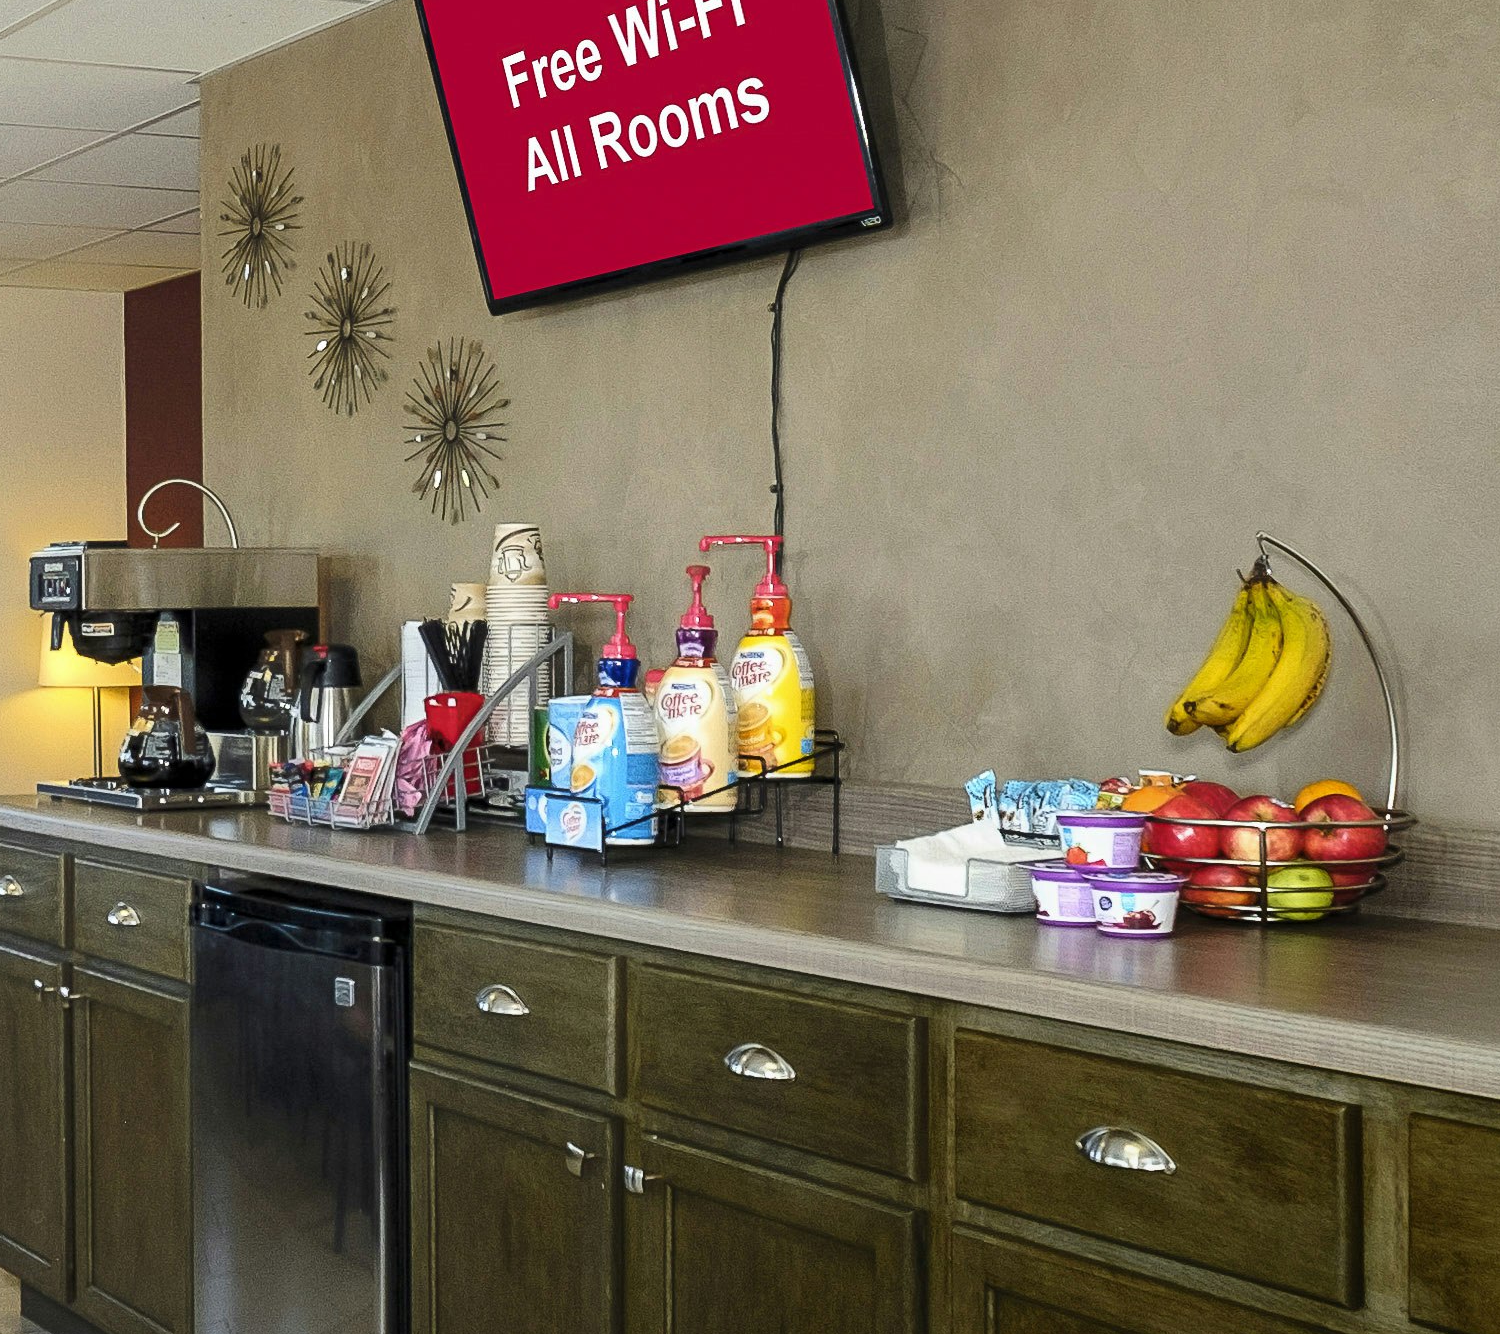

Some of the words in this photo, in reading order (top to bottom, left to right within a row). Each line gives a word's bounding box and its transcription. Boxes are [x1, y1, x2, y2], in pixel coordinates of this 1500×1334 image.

[502, 40, 603, 108] Free
[528, 125, 582, 192] All
[589, 78, 770, 170] Rooms
[661, 692, 699, 711] Coffee
